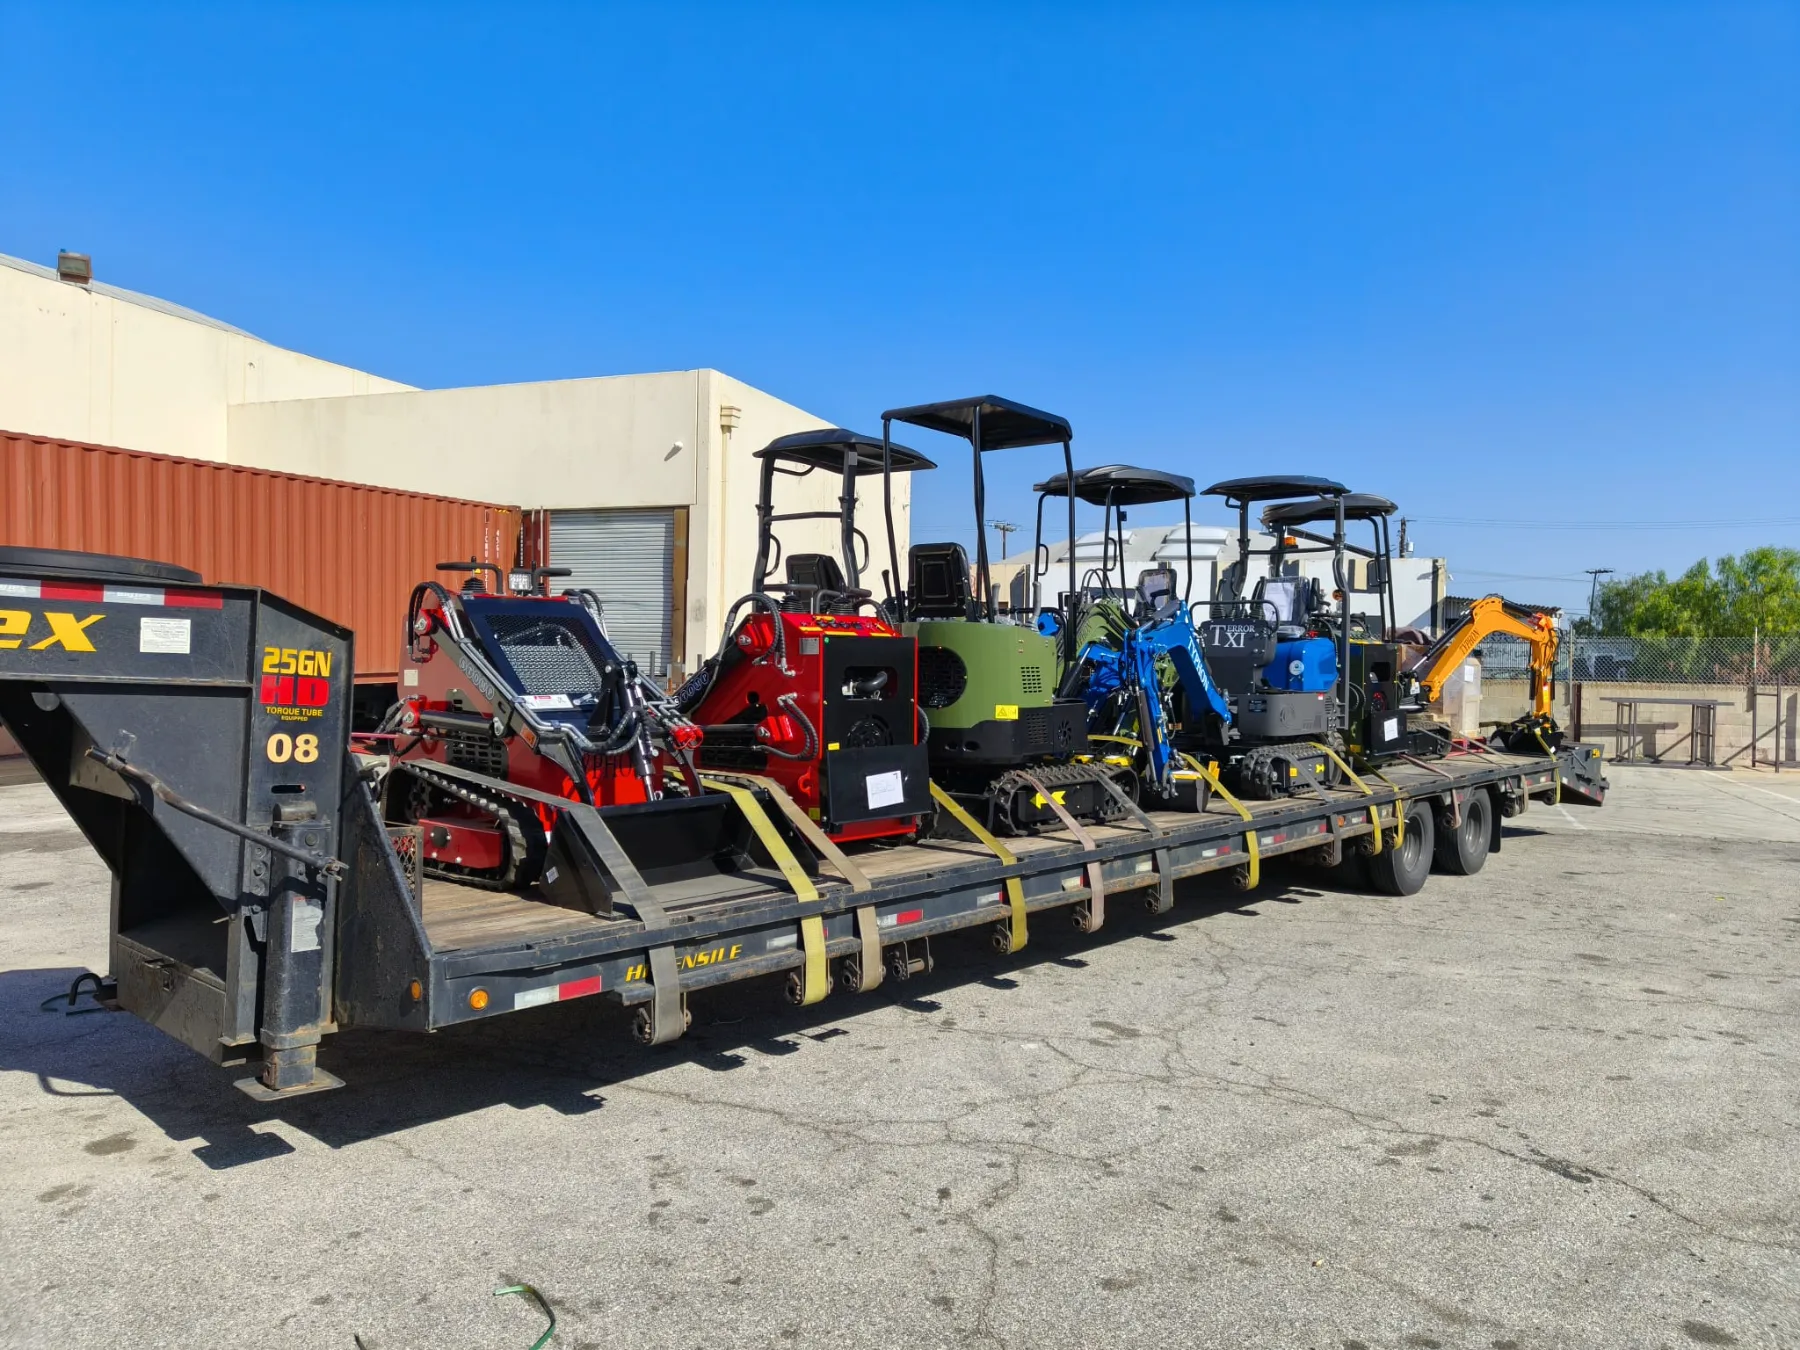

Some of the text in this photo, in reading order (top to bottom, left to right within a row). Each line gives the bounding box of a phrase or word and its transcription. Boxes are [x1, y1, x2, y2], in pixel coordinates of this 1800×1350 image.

[262, 646, 332, 677] 25GN
[259, 674, 330, 707] HD
[265, 706, 323, 717] TORQUE TUBE
[266, 733, 319, 763] 08
[675, 944, 743, 970] NSILE
